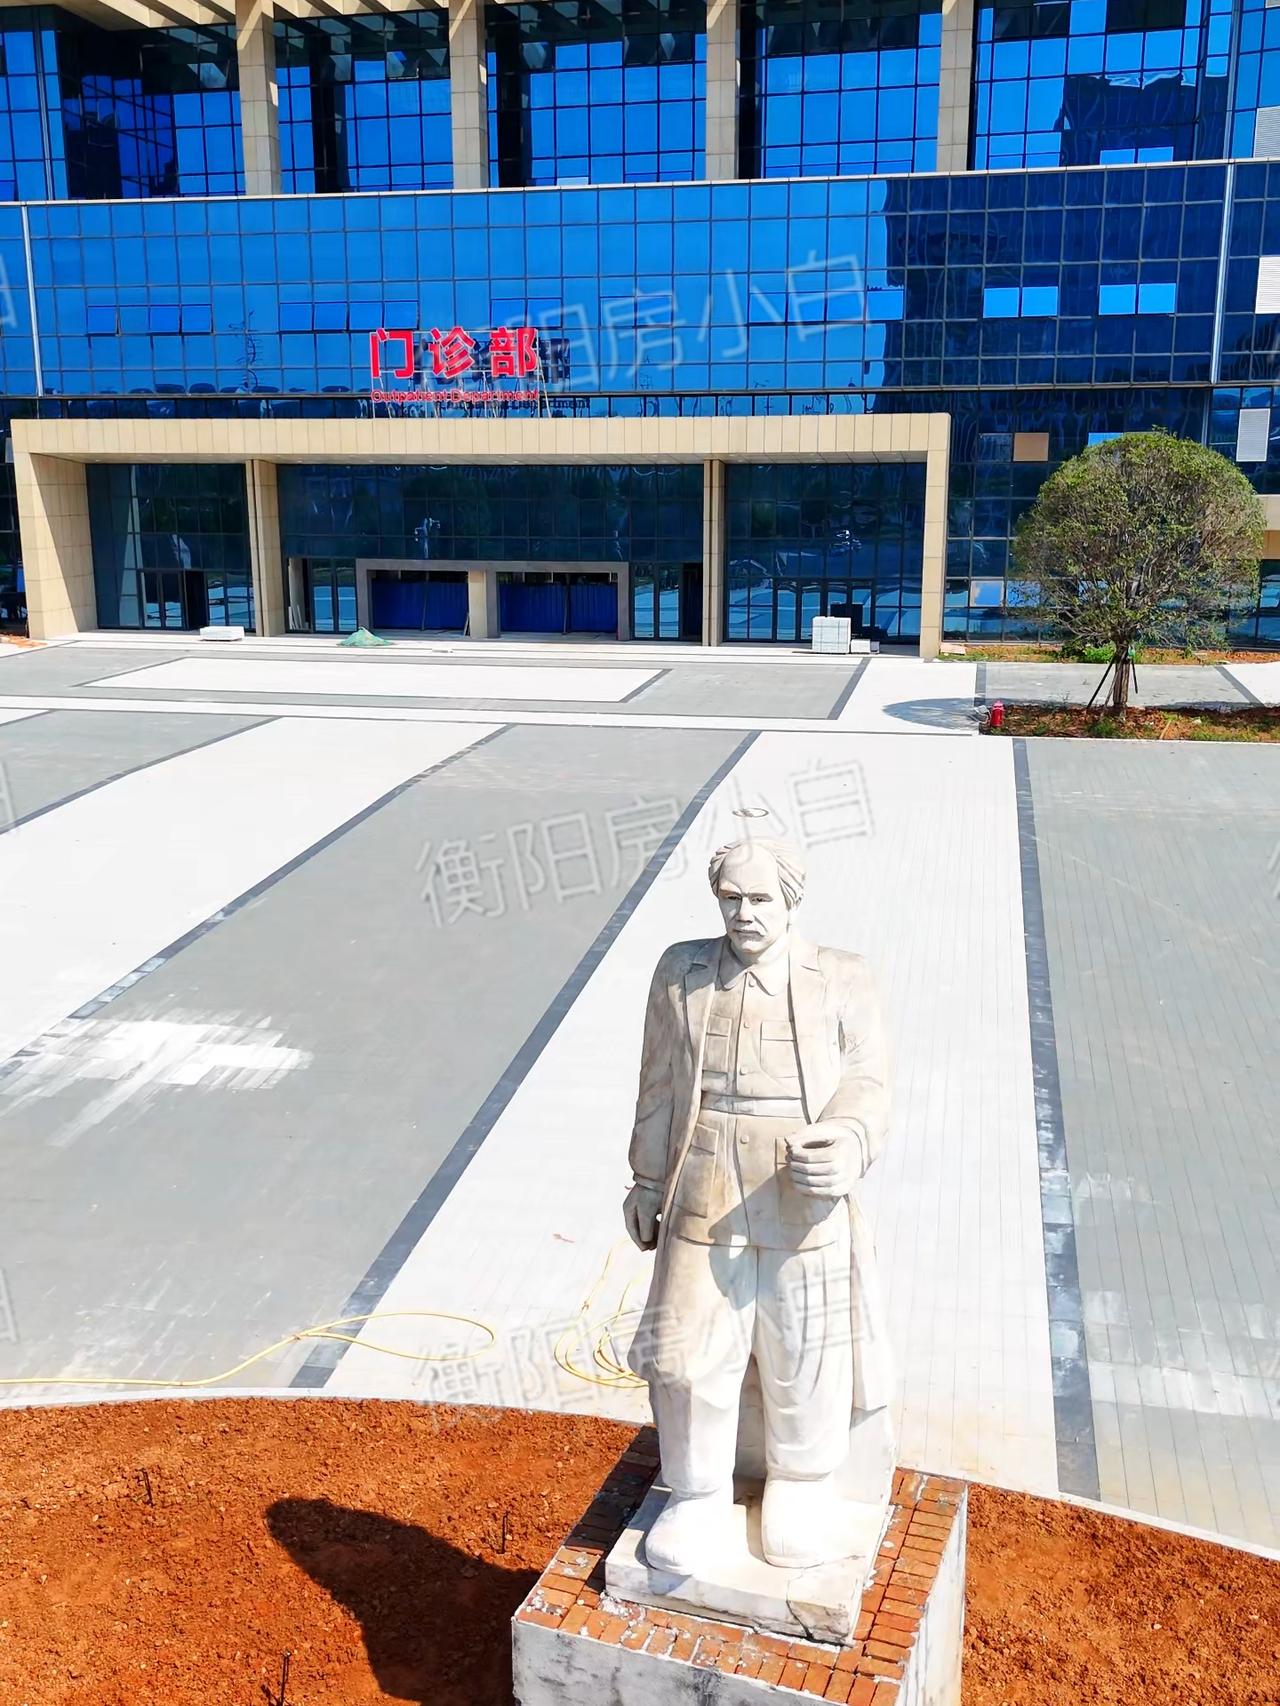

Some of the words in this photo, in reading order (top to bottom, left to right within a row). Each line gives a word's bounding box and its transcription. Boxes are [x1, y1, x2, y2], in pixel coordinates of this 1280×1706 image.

[369, 327, 539, 378] 门诊部
[371, 389, 446, 402] Outpatient
[450, 388, 539, 403] Department
